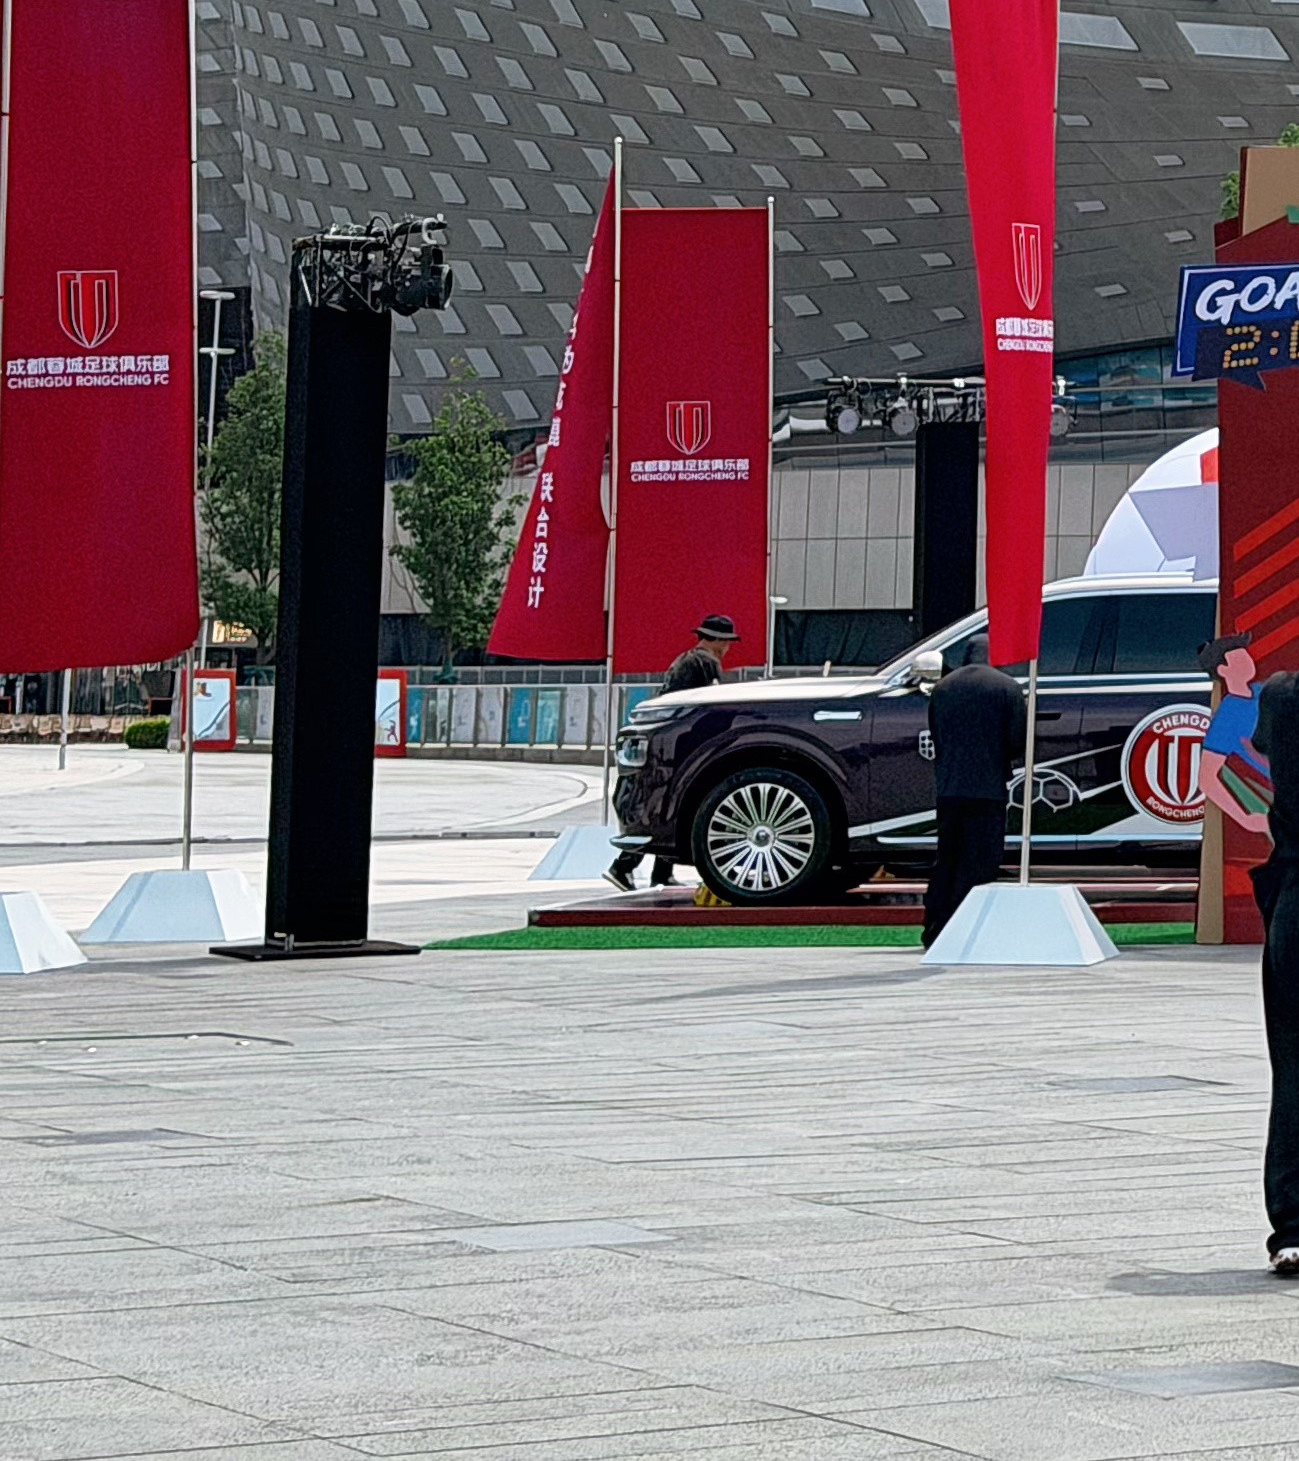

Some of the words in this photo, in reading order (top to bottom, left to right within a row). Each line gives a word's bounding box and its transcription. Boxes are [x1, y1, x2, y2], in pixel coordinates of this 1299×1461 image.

[6, 354, 169, 376] 成都蓉城足球俱乐部
[7, 376, 72, 389] CHENGDU
[76, 375, 151, 387] RONGCHENG
[154, 374, 169, 385] FC
[1152, 714, 1210, 734] CHENGD
